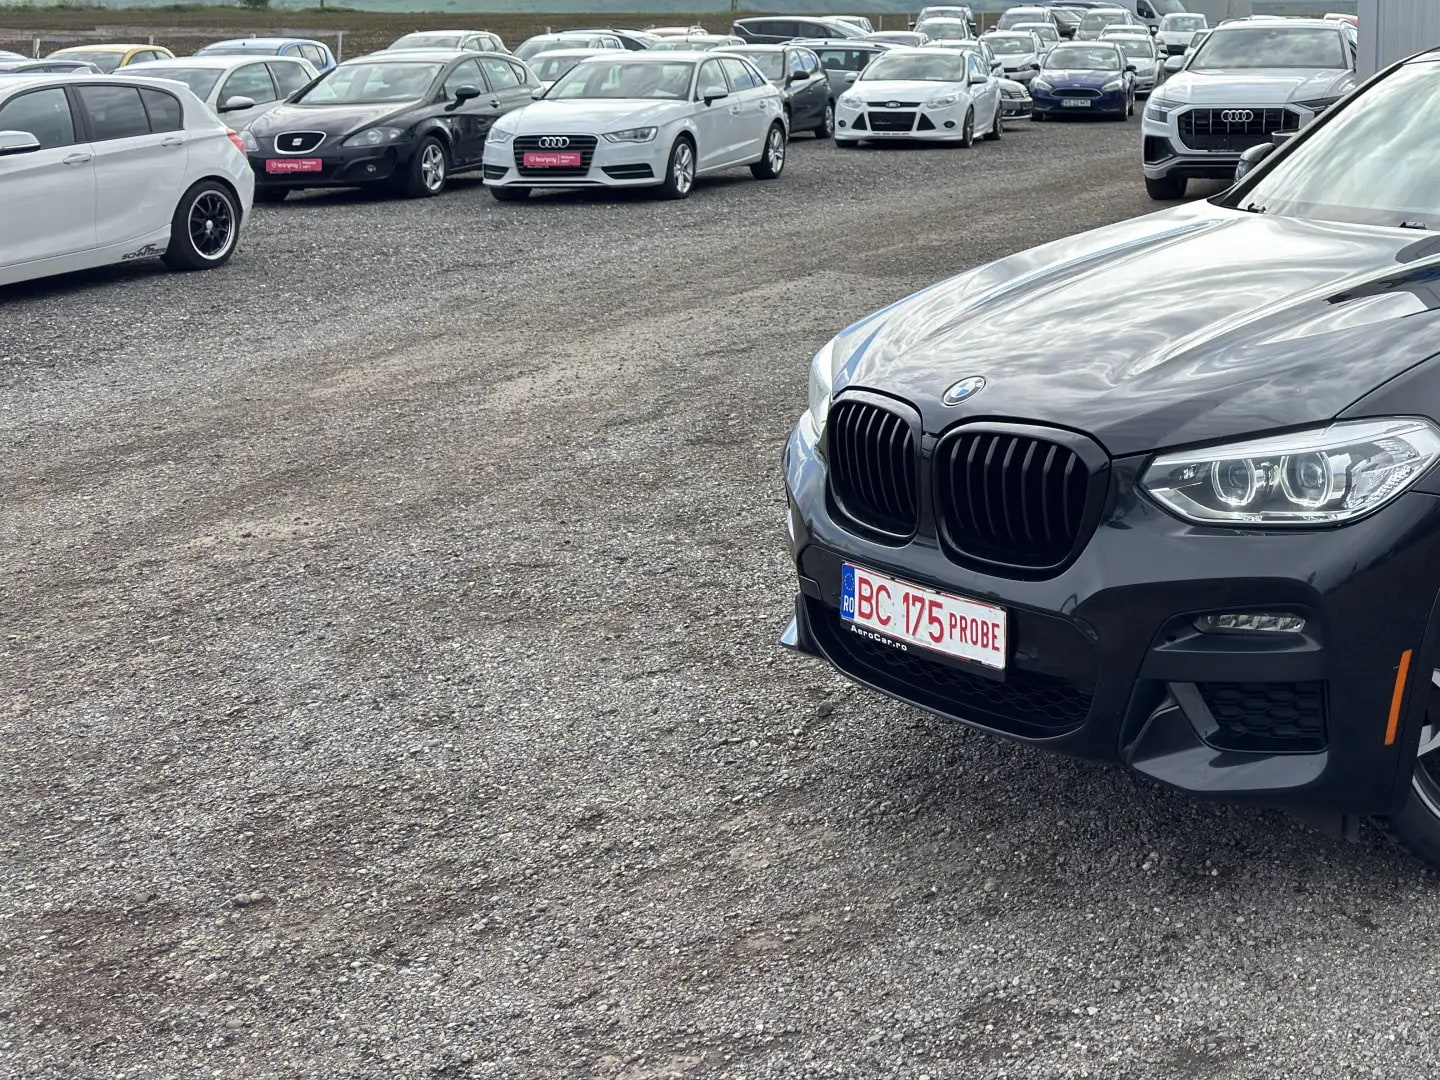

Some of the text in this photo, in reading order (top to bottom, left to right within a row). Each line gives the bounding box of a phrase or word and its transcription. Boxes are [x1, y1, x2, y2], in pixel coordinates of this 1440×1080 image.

[843, 594, 854, 613] RO
[858, 576, 1000, 652] BC 175 PROBE
[850, 624, 907, 652] AeroCar.ro
